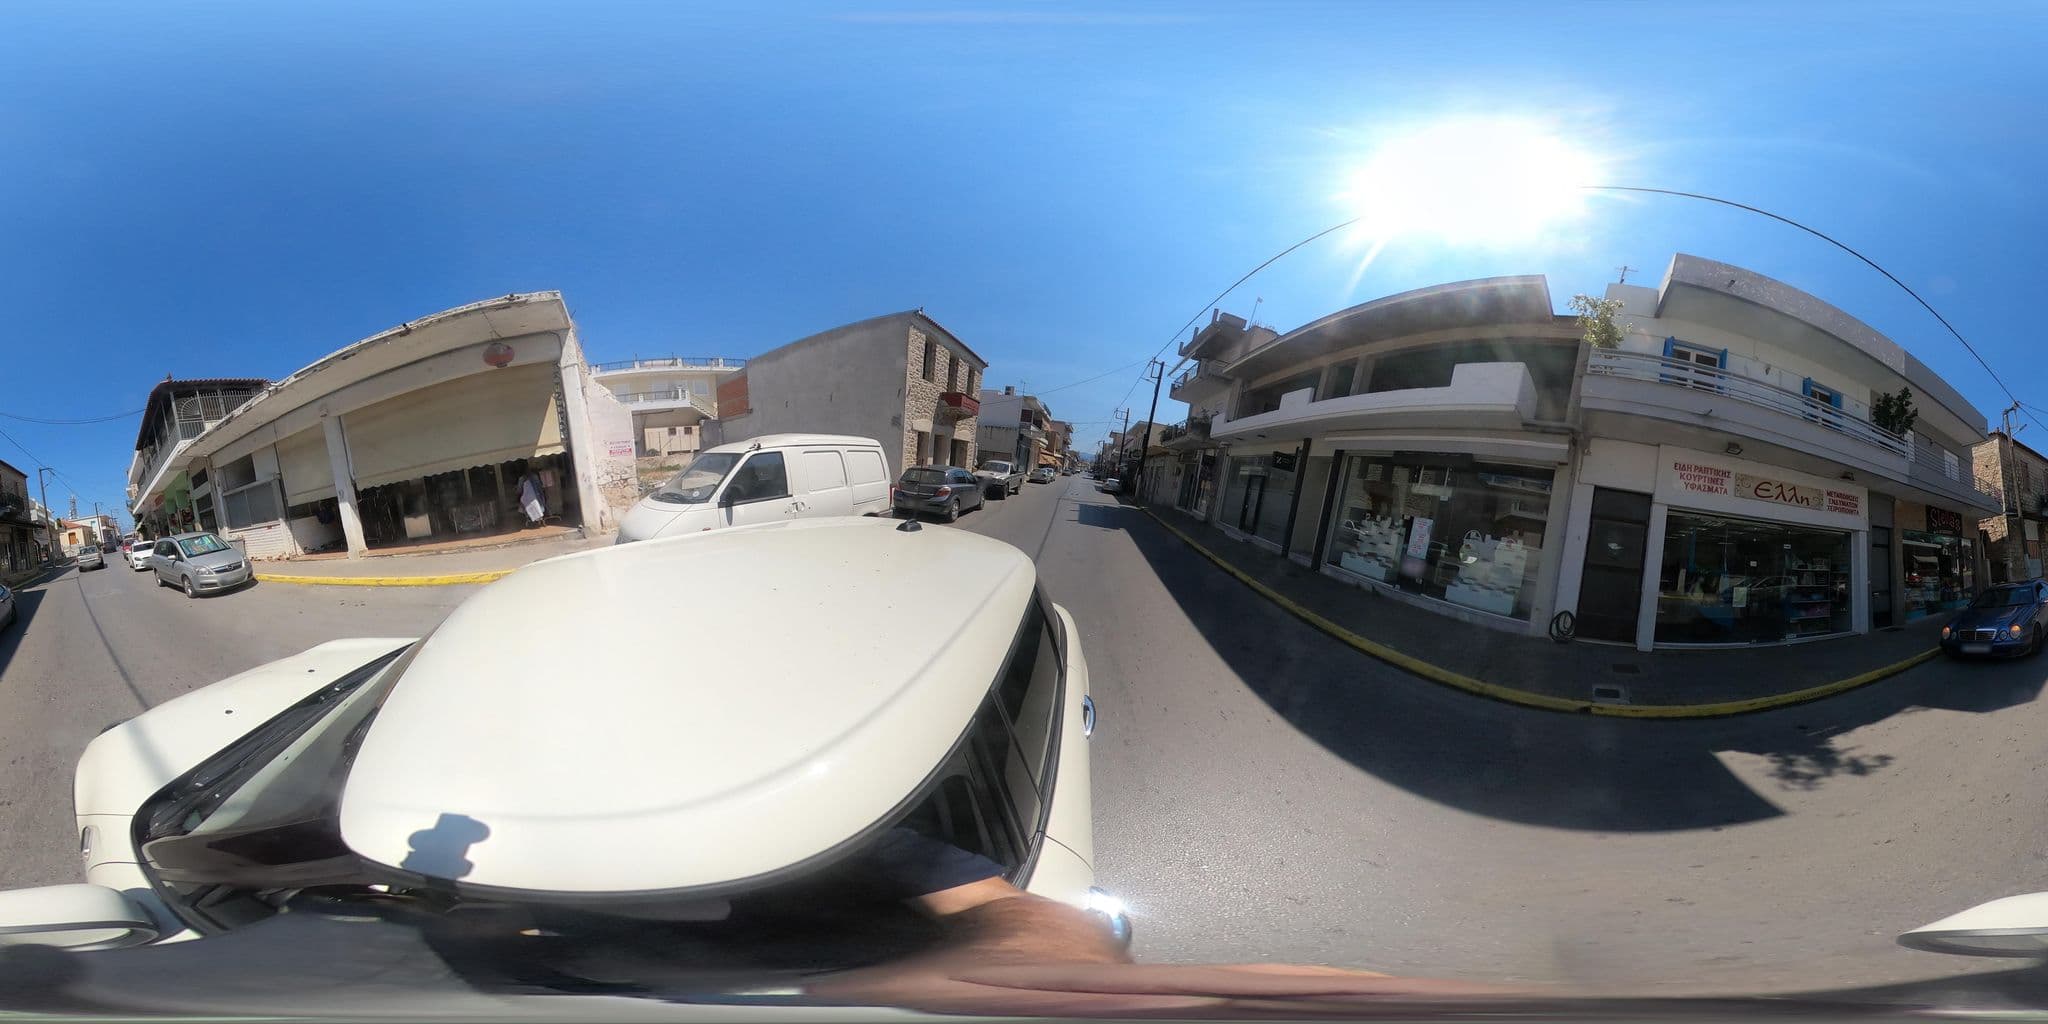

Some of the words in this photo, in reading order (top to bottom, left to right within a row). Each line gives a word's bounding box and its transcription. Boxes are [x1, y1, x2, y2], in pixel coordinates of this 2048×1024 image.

[1674, 462, 1693, 473] ΕΙΔΗ
[1693, 465, 1732, 479] ΡΑΠΤΙΚΗΣ
[1679, 472, 1725, 487] ΚΟΥΡΤΙΝΕΣ
[1683, 481, 1729, 496] ΥΦΑΣΜΑΤΑ
